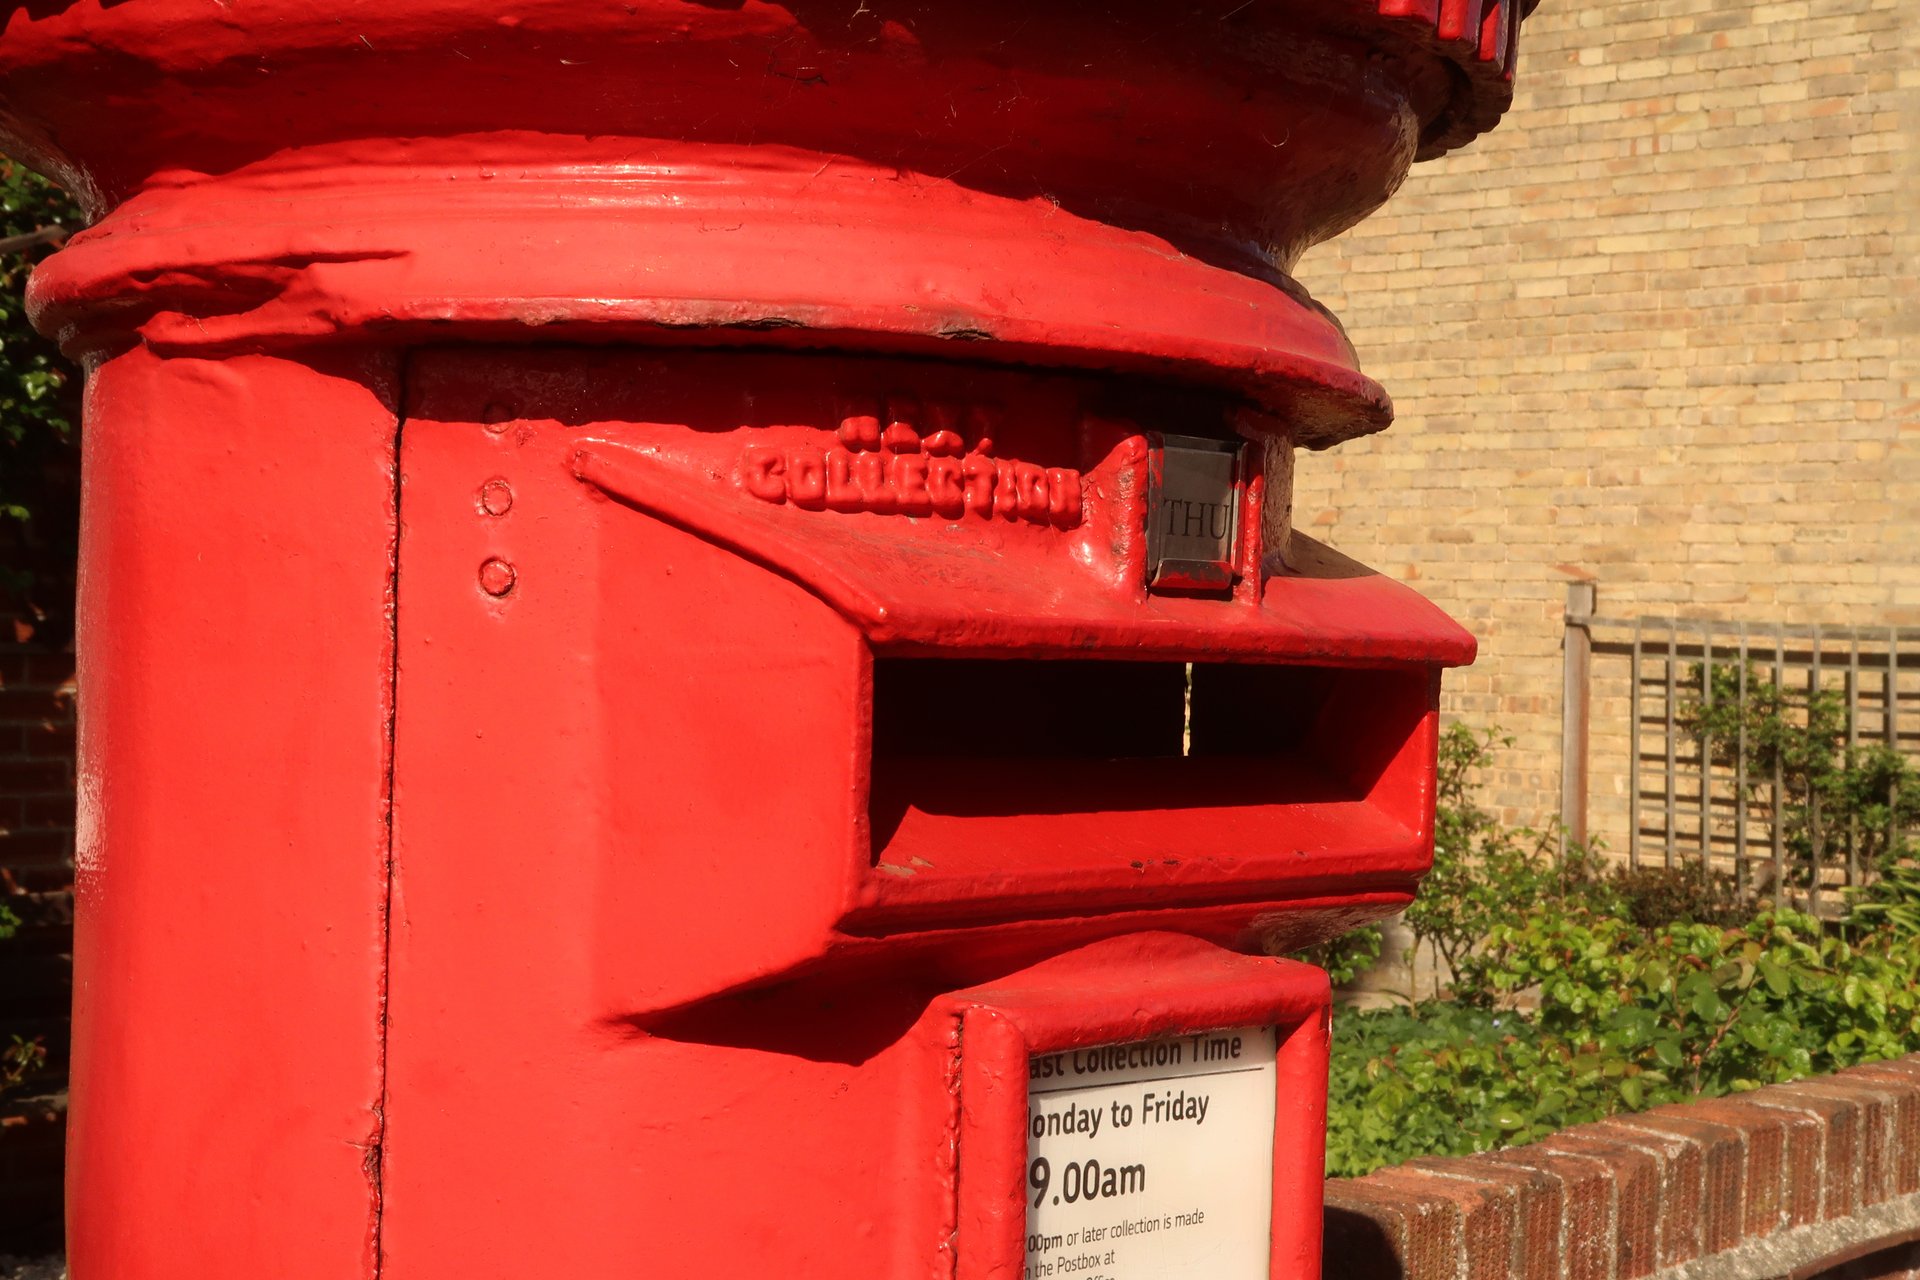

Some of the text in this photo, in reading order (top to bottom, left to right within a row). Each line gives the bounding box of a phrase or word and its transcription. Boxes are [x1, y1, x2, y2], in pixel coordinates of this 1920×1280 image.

[747, 448, 1082, 522] COLLECTION
[1163, 498, 1230, 540] THU
[1028, 1034, 1242, 1080] ast Collection Time
[1027, 1090, 1210, 1139] onday to Friday
[1029, 1156, 1146, 1209] 9.00am
[1027, 1208, 1205, 1255] 00pm or later collection is made
[1035, 1260, 1054, 1278] the
[1057, 1252, 1101, 1274] Postbox
[1103, 1249, 1116, 1266] at
